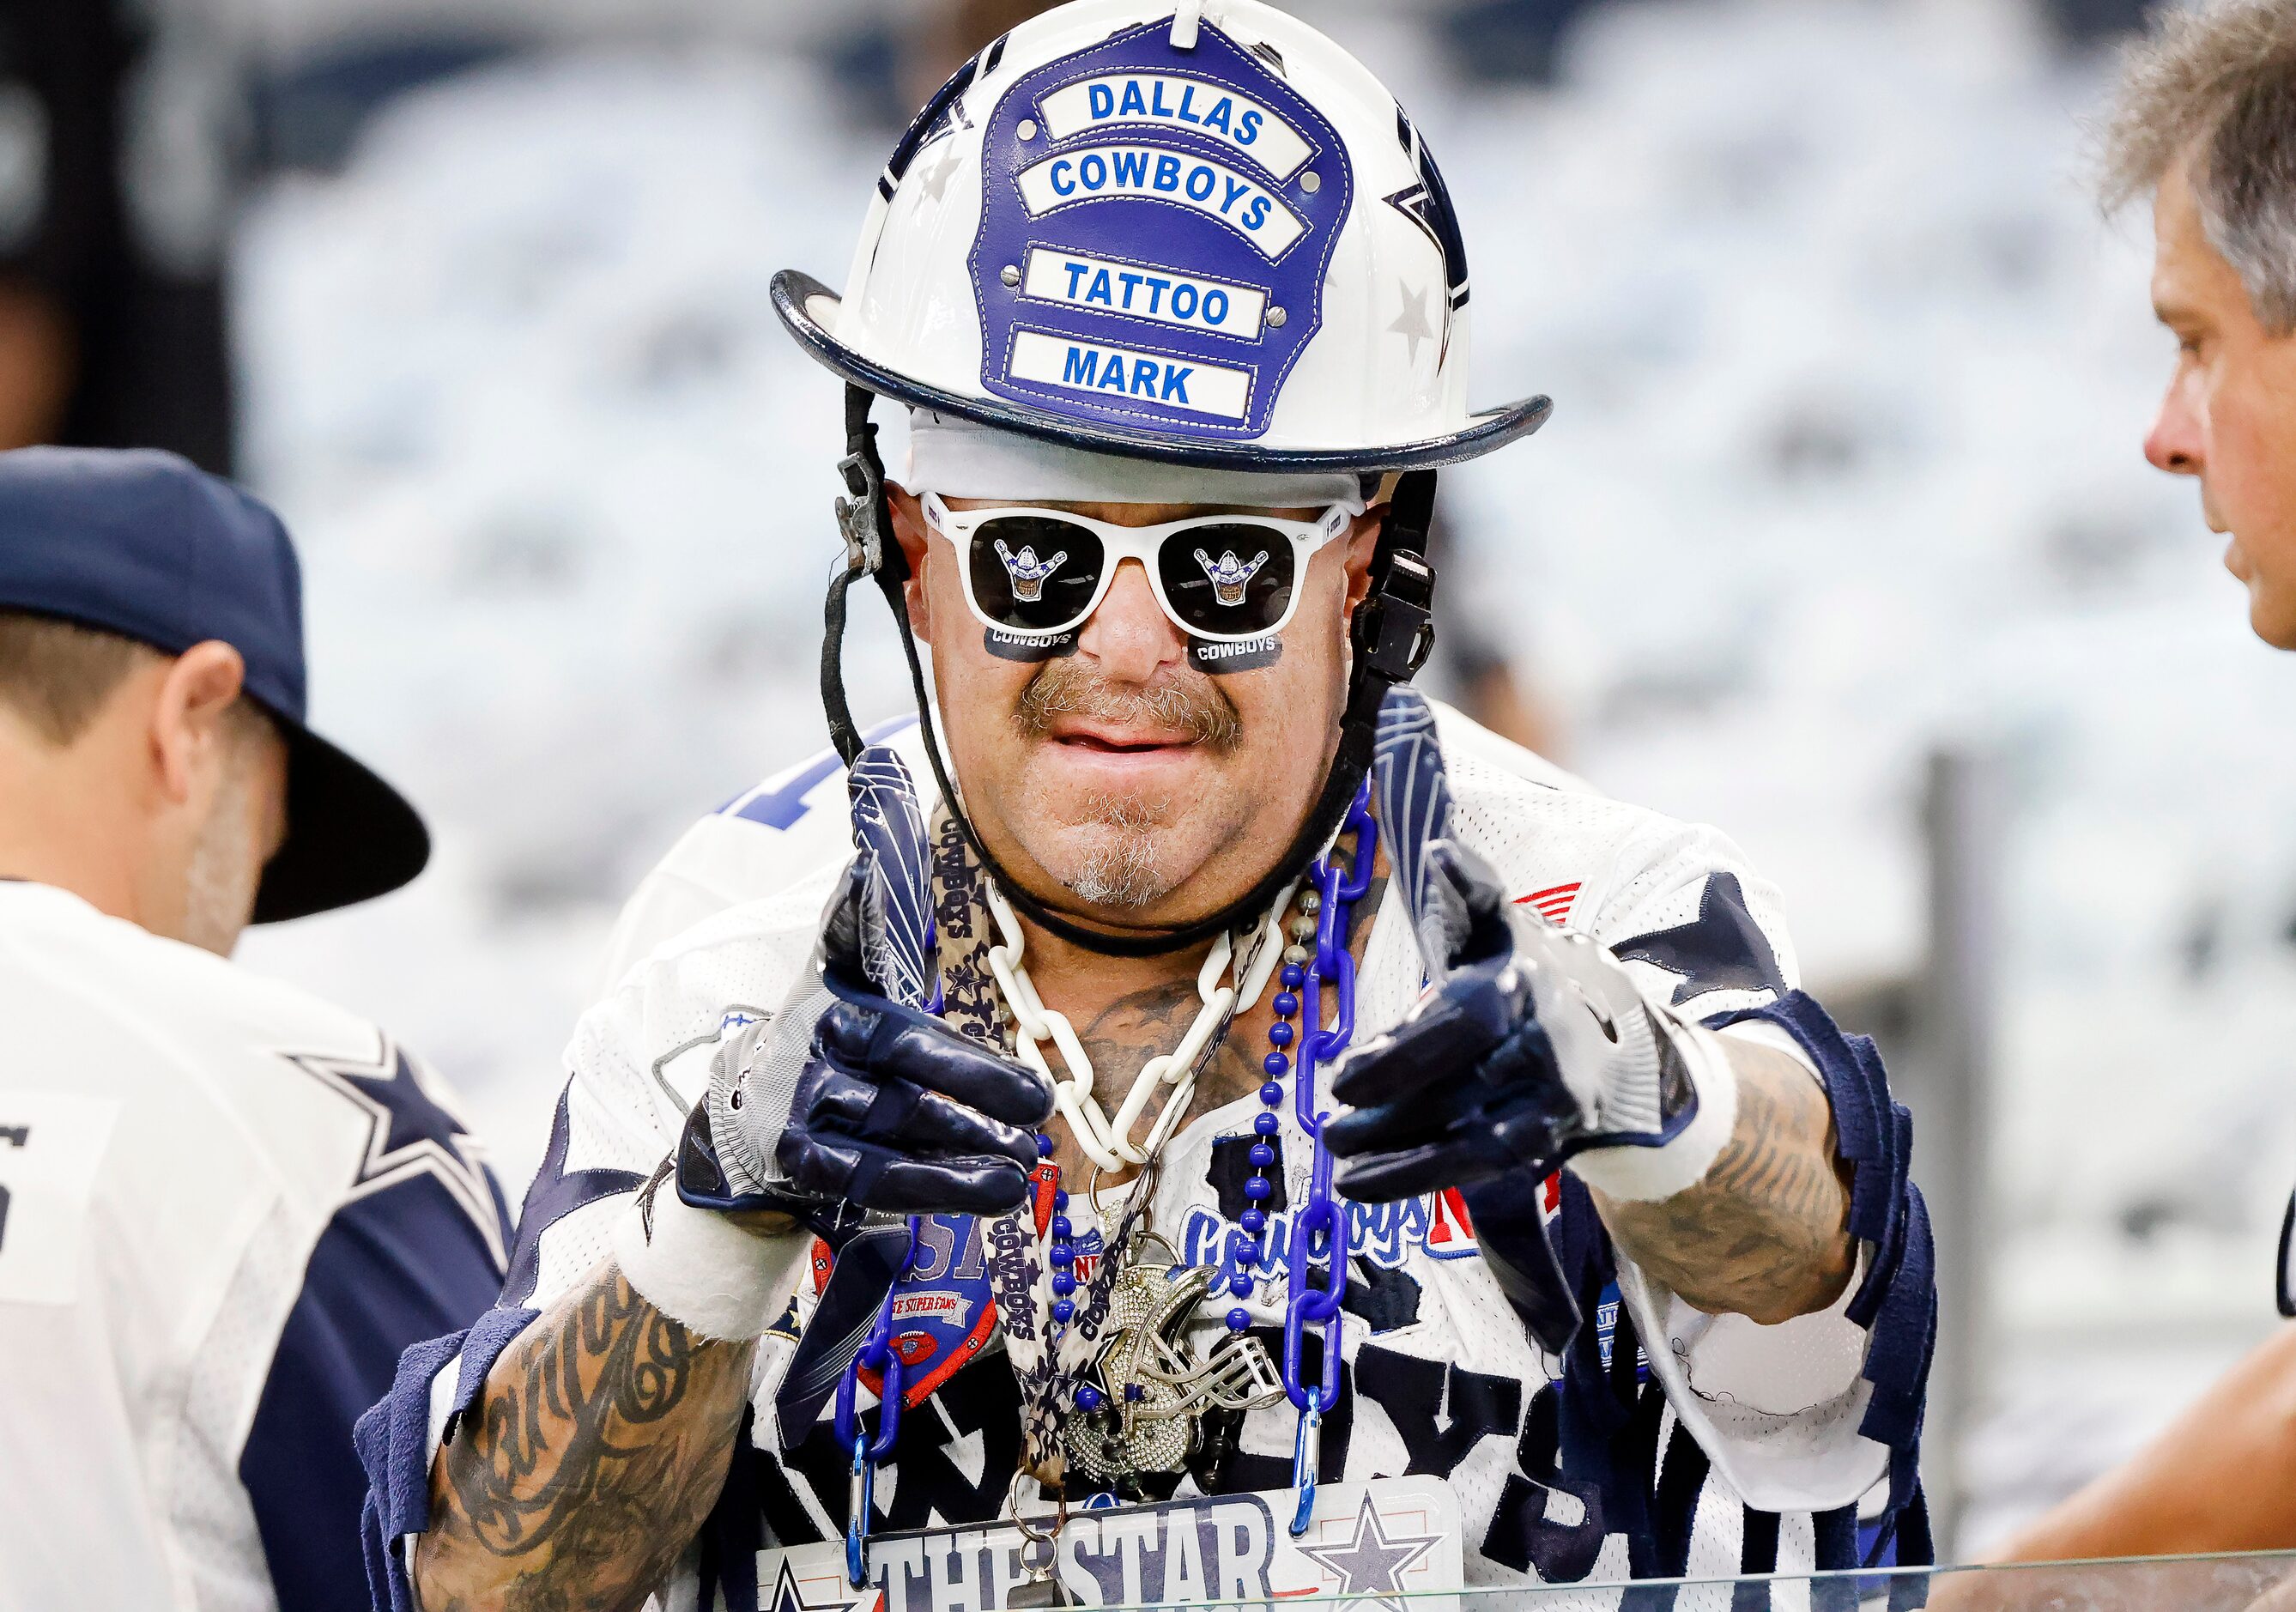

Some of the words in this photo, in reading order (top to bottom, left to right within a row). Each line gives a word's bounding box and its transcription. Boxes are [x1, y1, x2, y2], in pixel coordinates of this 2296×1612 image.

[1088, 80, 1263, 146] DALLAS
[1051, 152, 1272, 232] COWBOYS
[1064, 262, 1229, 326] TATTOO
[1063, 348, 1195, 404] MARK
[992, 628, 1071, 648] COWBOYS
[1197, 636, 1275, 660] COWBOYS
[940, 819, 972, 938] COWBOYS
[992, 1218, 1036, 1341] COWBOYS
[872, 1521, 1037, 1611] THE
[1058, 1502, 1267, 1611] STAR
